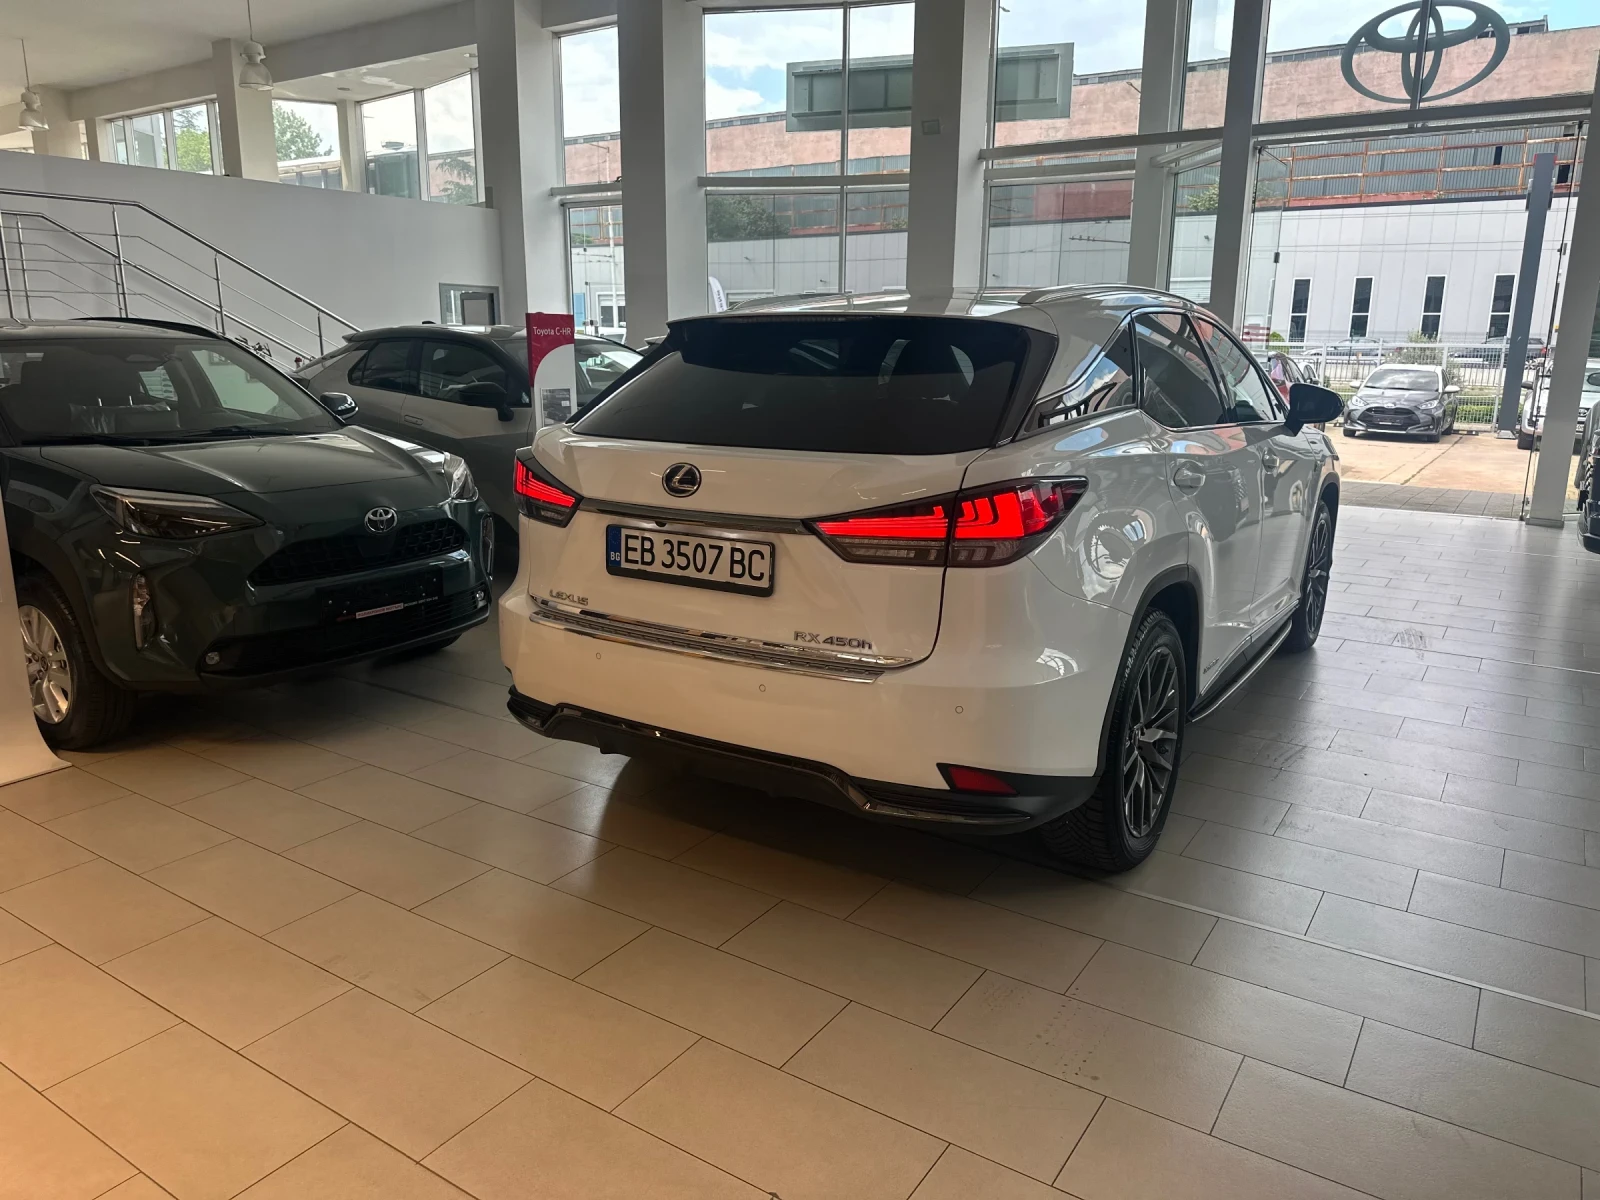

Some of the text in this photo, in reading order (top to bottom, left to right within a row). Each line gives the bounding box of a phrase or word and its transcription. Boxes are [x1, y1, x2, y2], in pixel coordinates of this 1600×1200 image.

[532, 326, 572, 337] Toyota C-HR
[610, 551, 621, 561] BG
[624, 533, 765, 582] EB 3507 BC
[549, 589, 589, 606] LEXUS
[793, 630, 873, 650] RX 450h
